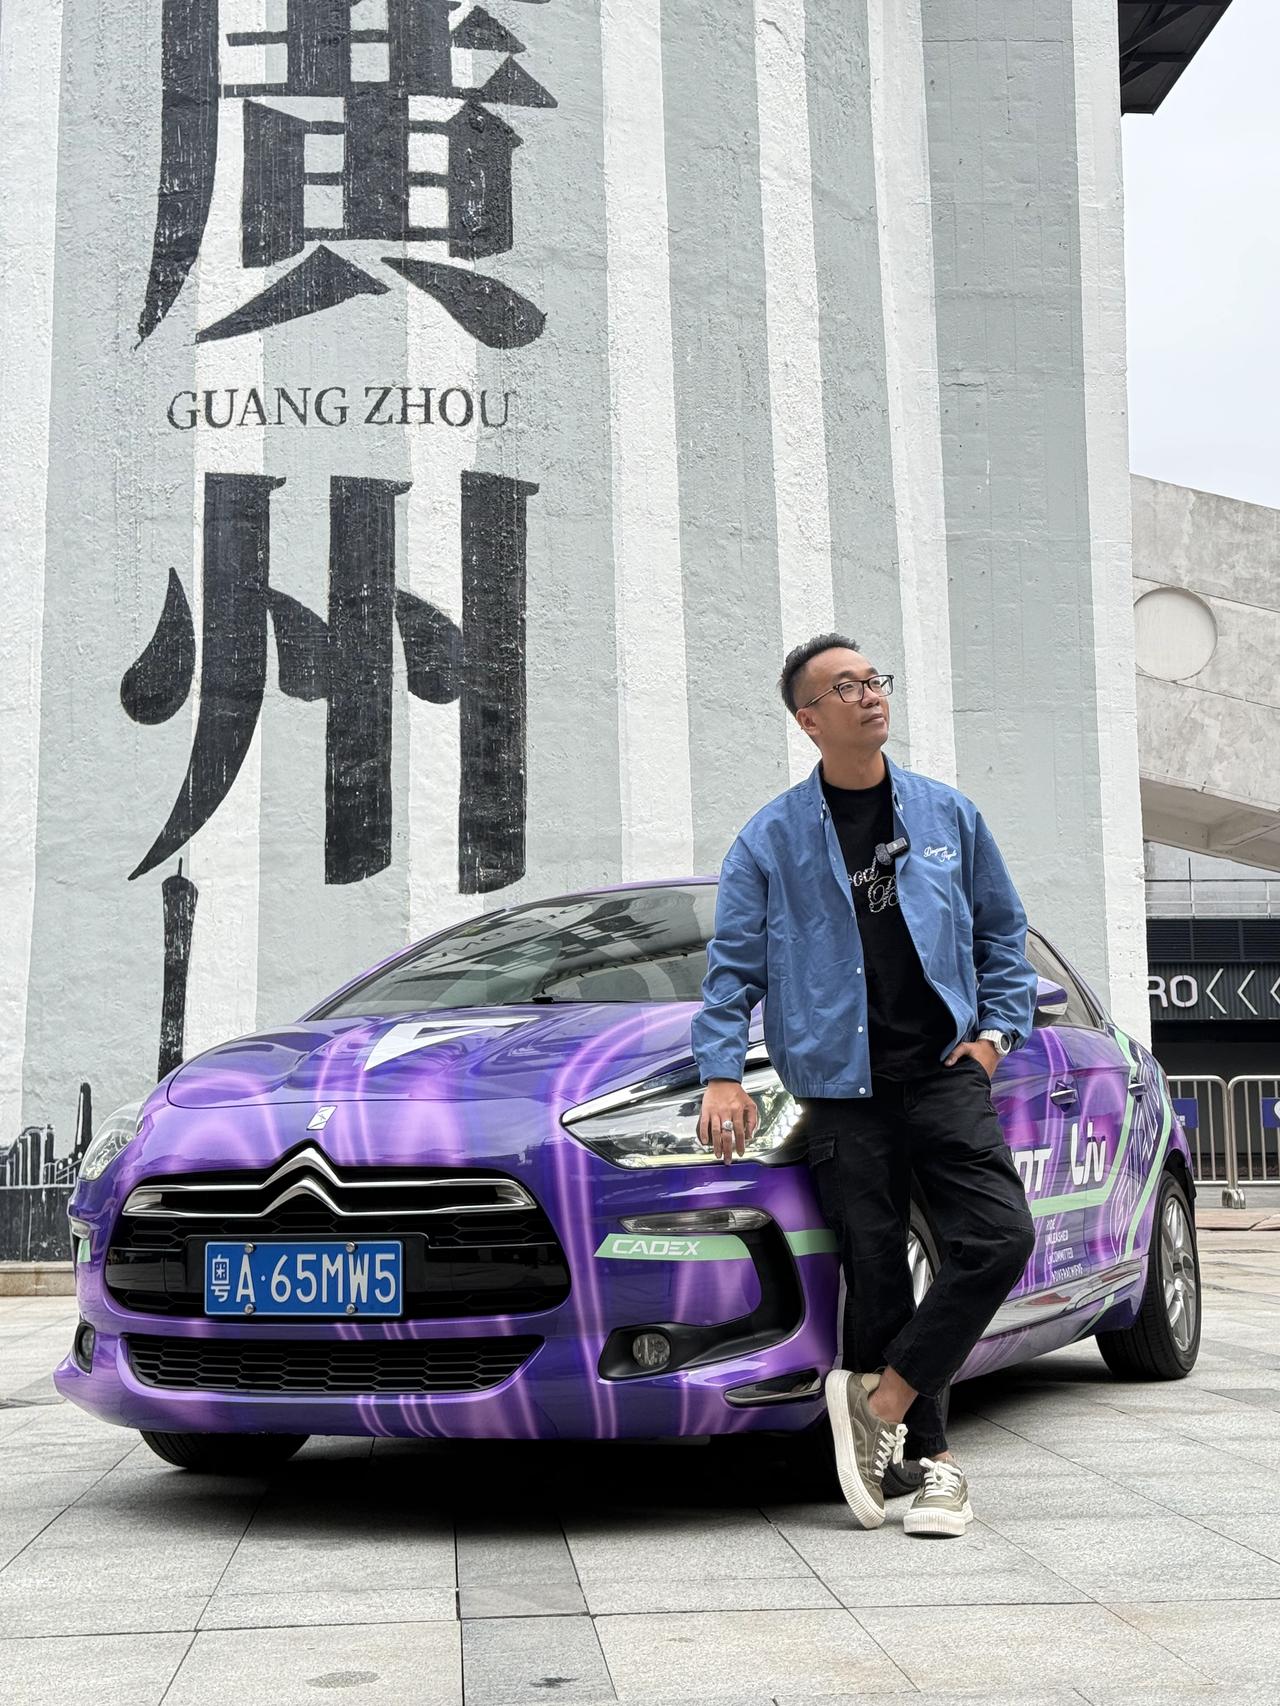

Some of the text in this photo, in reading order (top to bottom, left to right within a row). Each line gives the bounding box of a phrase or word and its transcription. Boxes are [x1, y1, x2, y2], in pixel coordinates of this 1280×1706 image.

[134, 0, 559, 350] 廣
[167, 386, 511, 430] GUANG ZHOU
[120, 469, 540, 895] 州
[612, 1239, 701, 1256] CADEX
